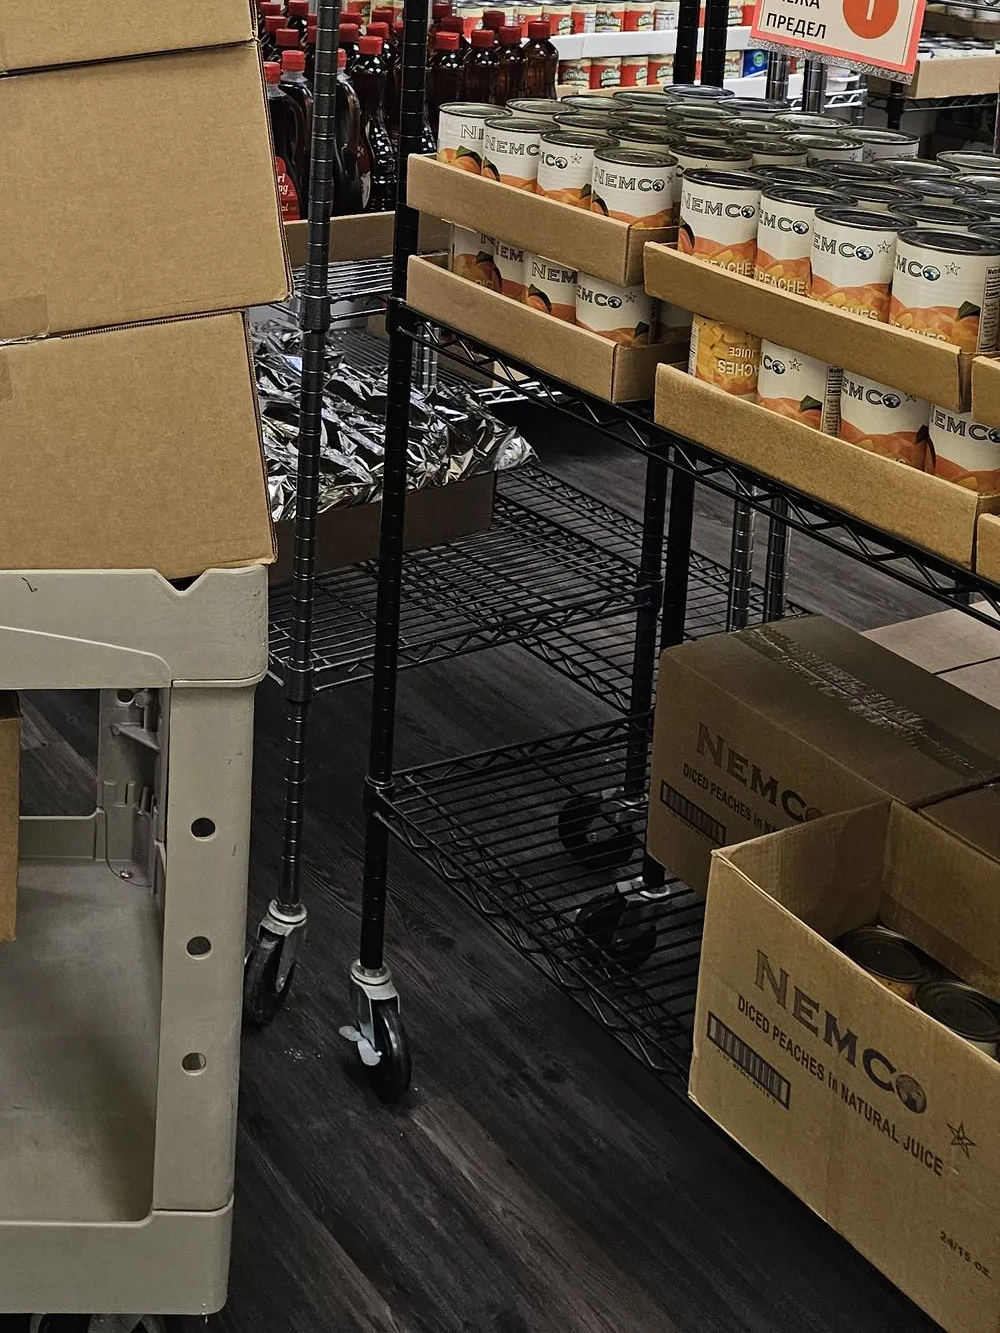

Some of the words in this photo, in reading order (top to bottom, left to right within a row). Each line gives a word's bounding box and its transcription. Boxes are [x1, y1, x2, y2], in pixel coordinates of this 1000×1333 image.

[766, 12, 827, 39] ПРЕДЕЛ
[485, 134, 540, 157] NEMC
[593, 166, 665, 192] NEMCO
[813, 231, 874, 261] EMCO
[531, 261, 578, 284] NEM
[896, 254, 941, 281] MCO
[717, 359, 760, 377] ACHES
[841, 376, 901, 408] EMCO
[683, 762, 709, 790] DICED
[710, 779, 751, 821] PEACHES
[754, 948, 928, 1114] NEMCO
[738, 994, 770, 1034] DICED
[772, 1025, 825, 1082] PEACHES
[828, 1070, 838, 1095] in
[841, 1083, 899, 1144] NATURAL
[902, 1134, 944, 1177] JUICE
